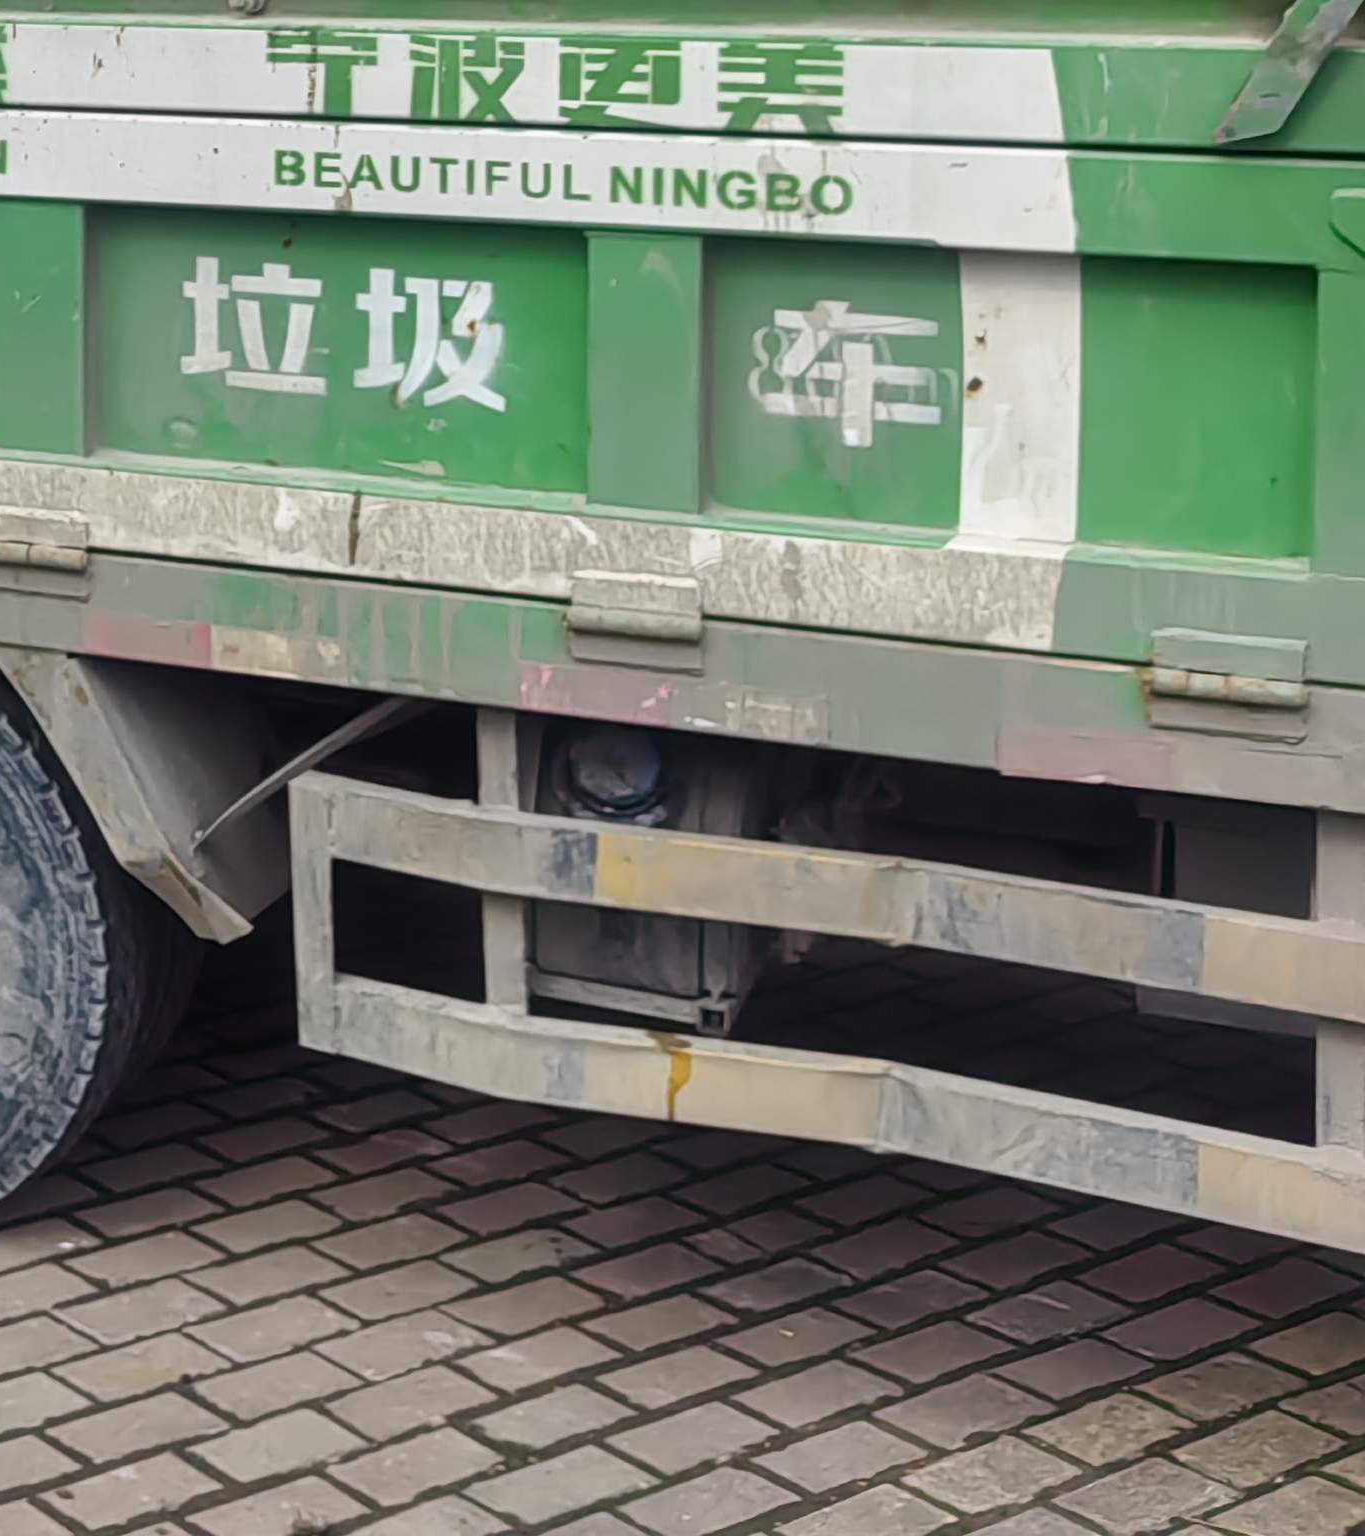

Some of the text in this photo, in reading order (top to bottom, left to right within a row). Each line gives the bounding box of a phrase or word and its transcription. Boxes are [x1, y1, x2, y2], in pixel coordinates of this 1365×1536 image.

[274, 149, 854, 216] BEAUTIFUL NINGBO
[181, 256, 507, 412] 垃圾
[765, 300, 941, 447] 车
